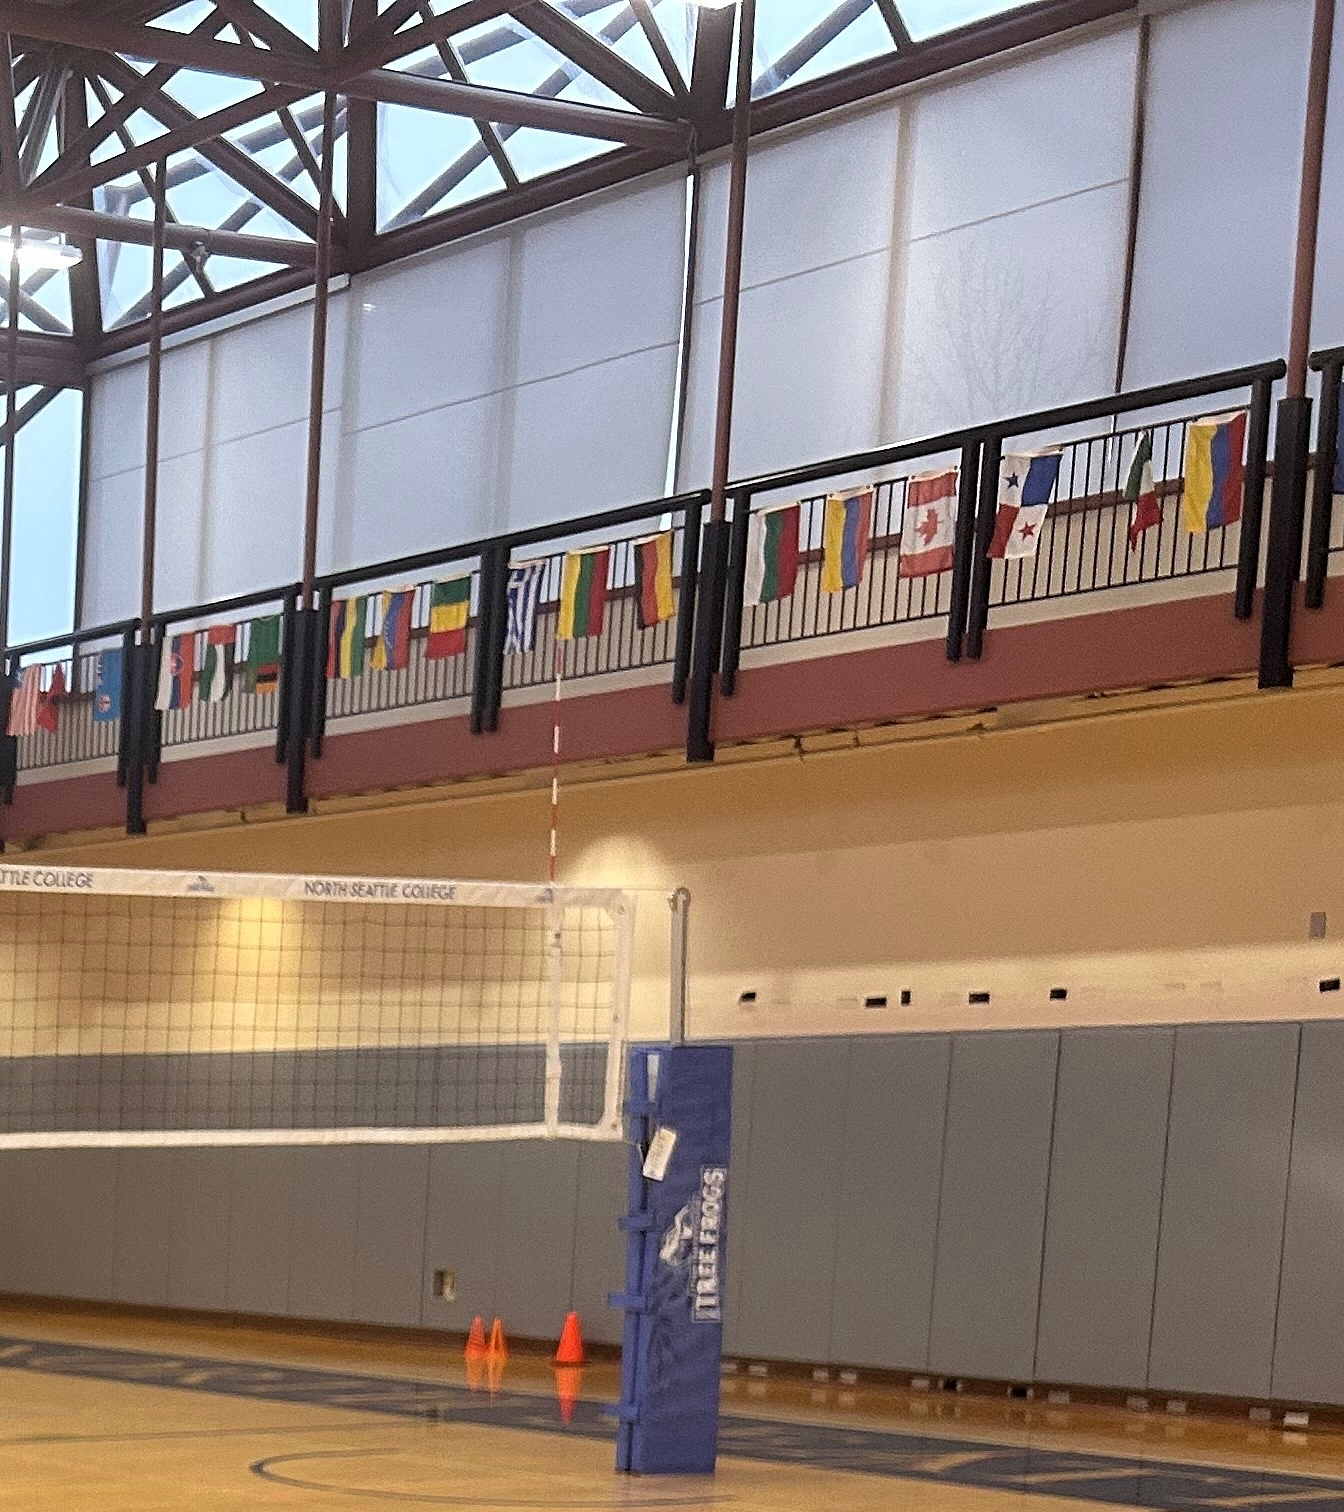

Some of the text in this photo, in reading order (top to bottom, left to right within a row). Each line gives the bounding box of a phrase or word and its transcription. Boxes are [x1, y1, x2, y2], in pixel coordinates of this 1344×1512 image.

[33, 871, 94, 888] COLLEGE
[304, 880, 456, 900] NORTH SEATTLE COLLEGE
[699, 1168, 724, 1245] FROGS
